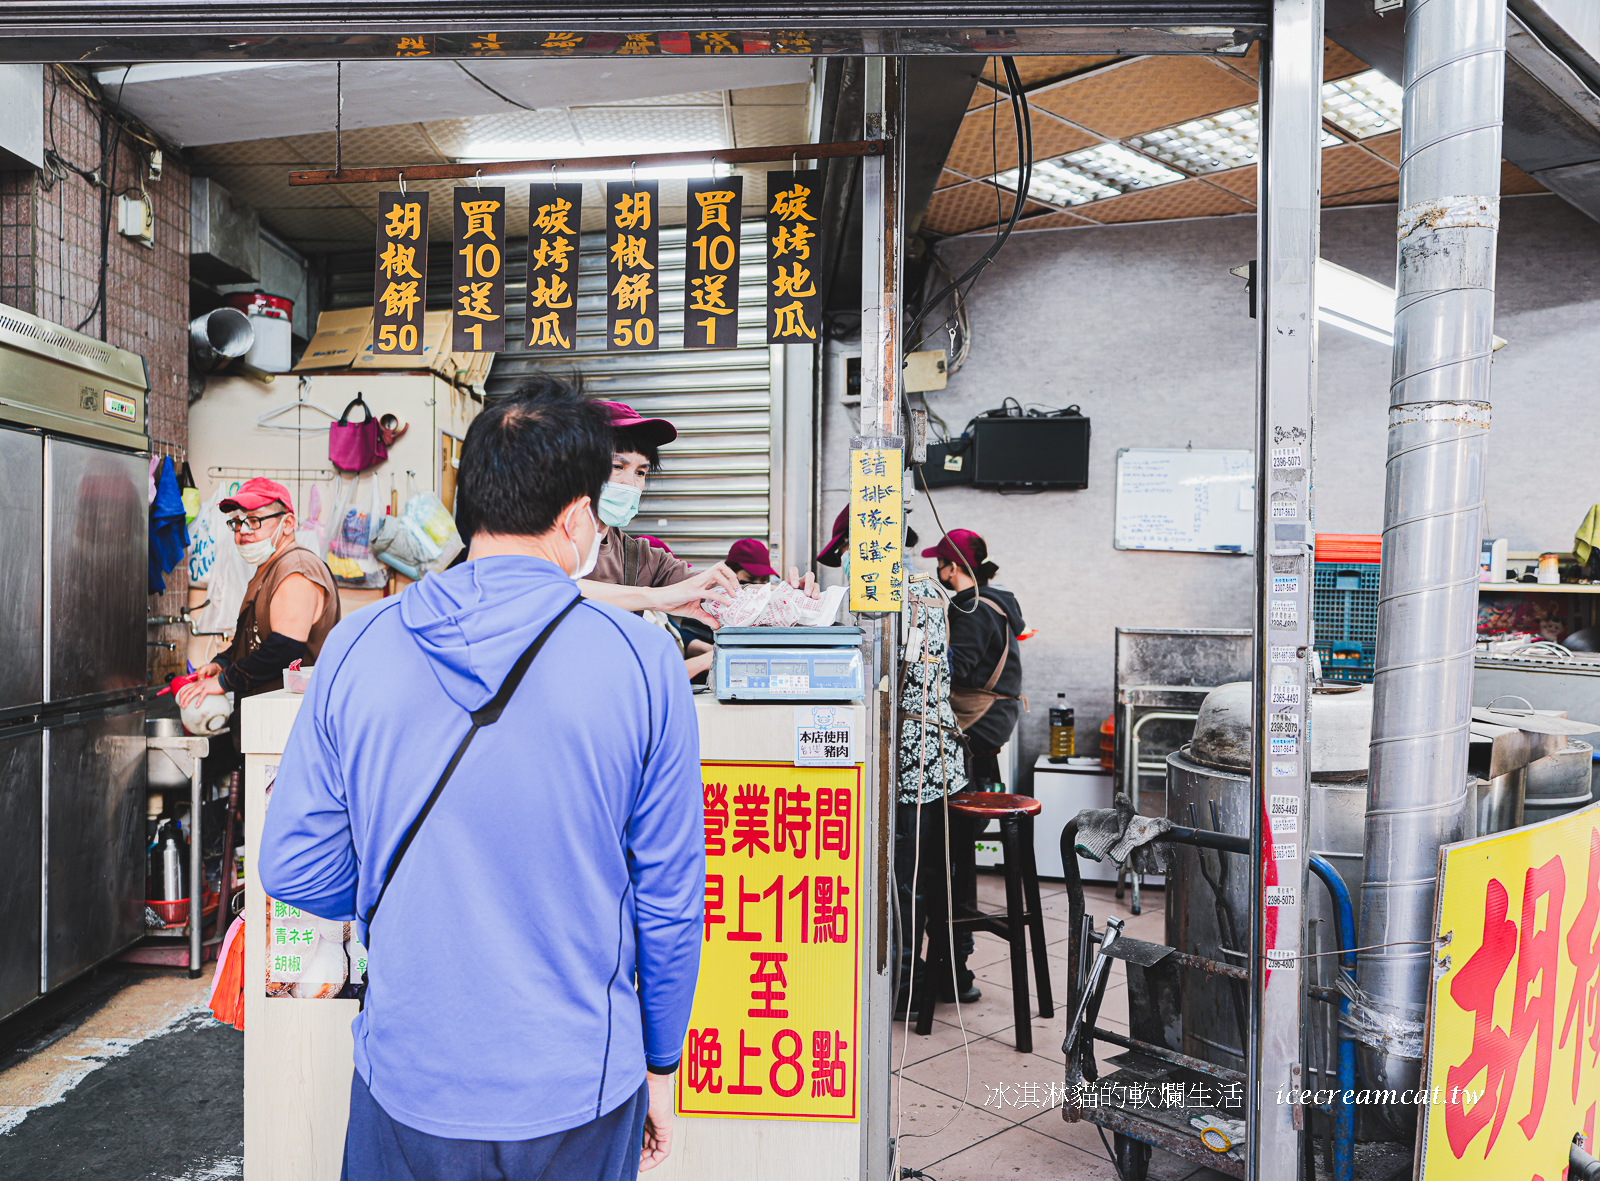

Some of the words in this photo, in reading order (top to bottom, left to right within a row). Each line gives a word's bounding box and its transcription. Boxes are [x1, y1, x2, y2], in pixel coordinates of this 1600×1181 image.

[770, 183, 817, 340] 碳烤地瓜
[529, 197, 577, 350] 碳烤地瓜
[1273, 455, 1301, 467] 2396-5073
[857, 453, 887, 602] 請排隊購買
[1272, 693, 1299, 704] 2365-4493
[1270, 722, 1298, 733] 2396-5073
[799, 731, 849, 744] 本店使用
[824, 745, 849, 758] 豬肉
[1271, 803, 1299, 815] 2365-4493
[701, 782, 851, 861] 營業時間
[1267, 894, 1295, 905] 2396-5073
[274, 901, 301, 918] 豚肉
[704, 874, 849, 945] 早上11點
[275, 927, 314, 945] 青ネギ
[274, 955, 301, 972] 胡椒
[747, 951, 789, 1019] 至
[687, 1027, 848, 1098] 晚上8點
